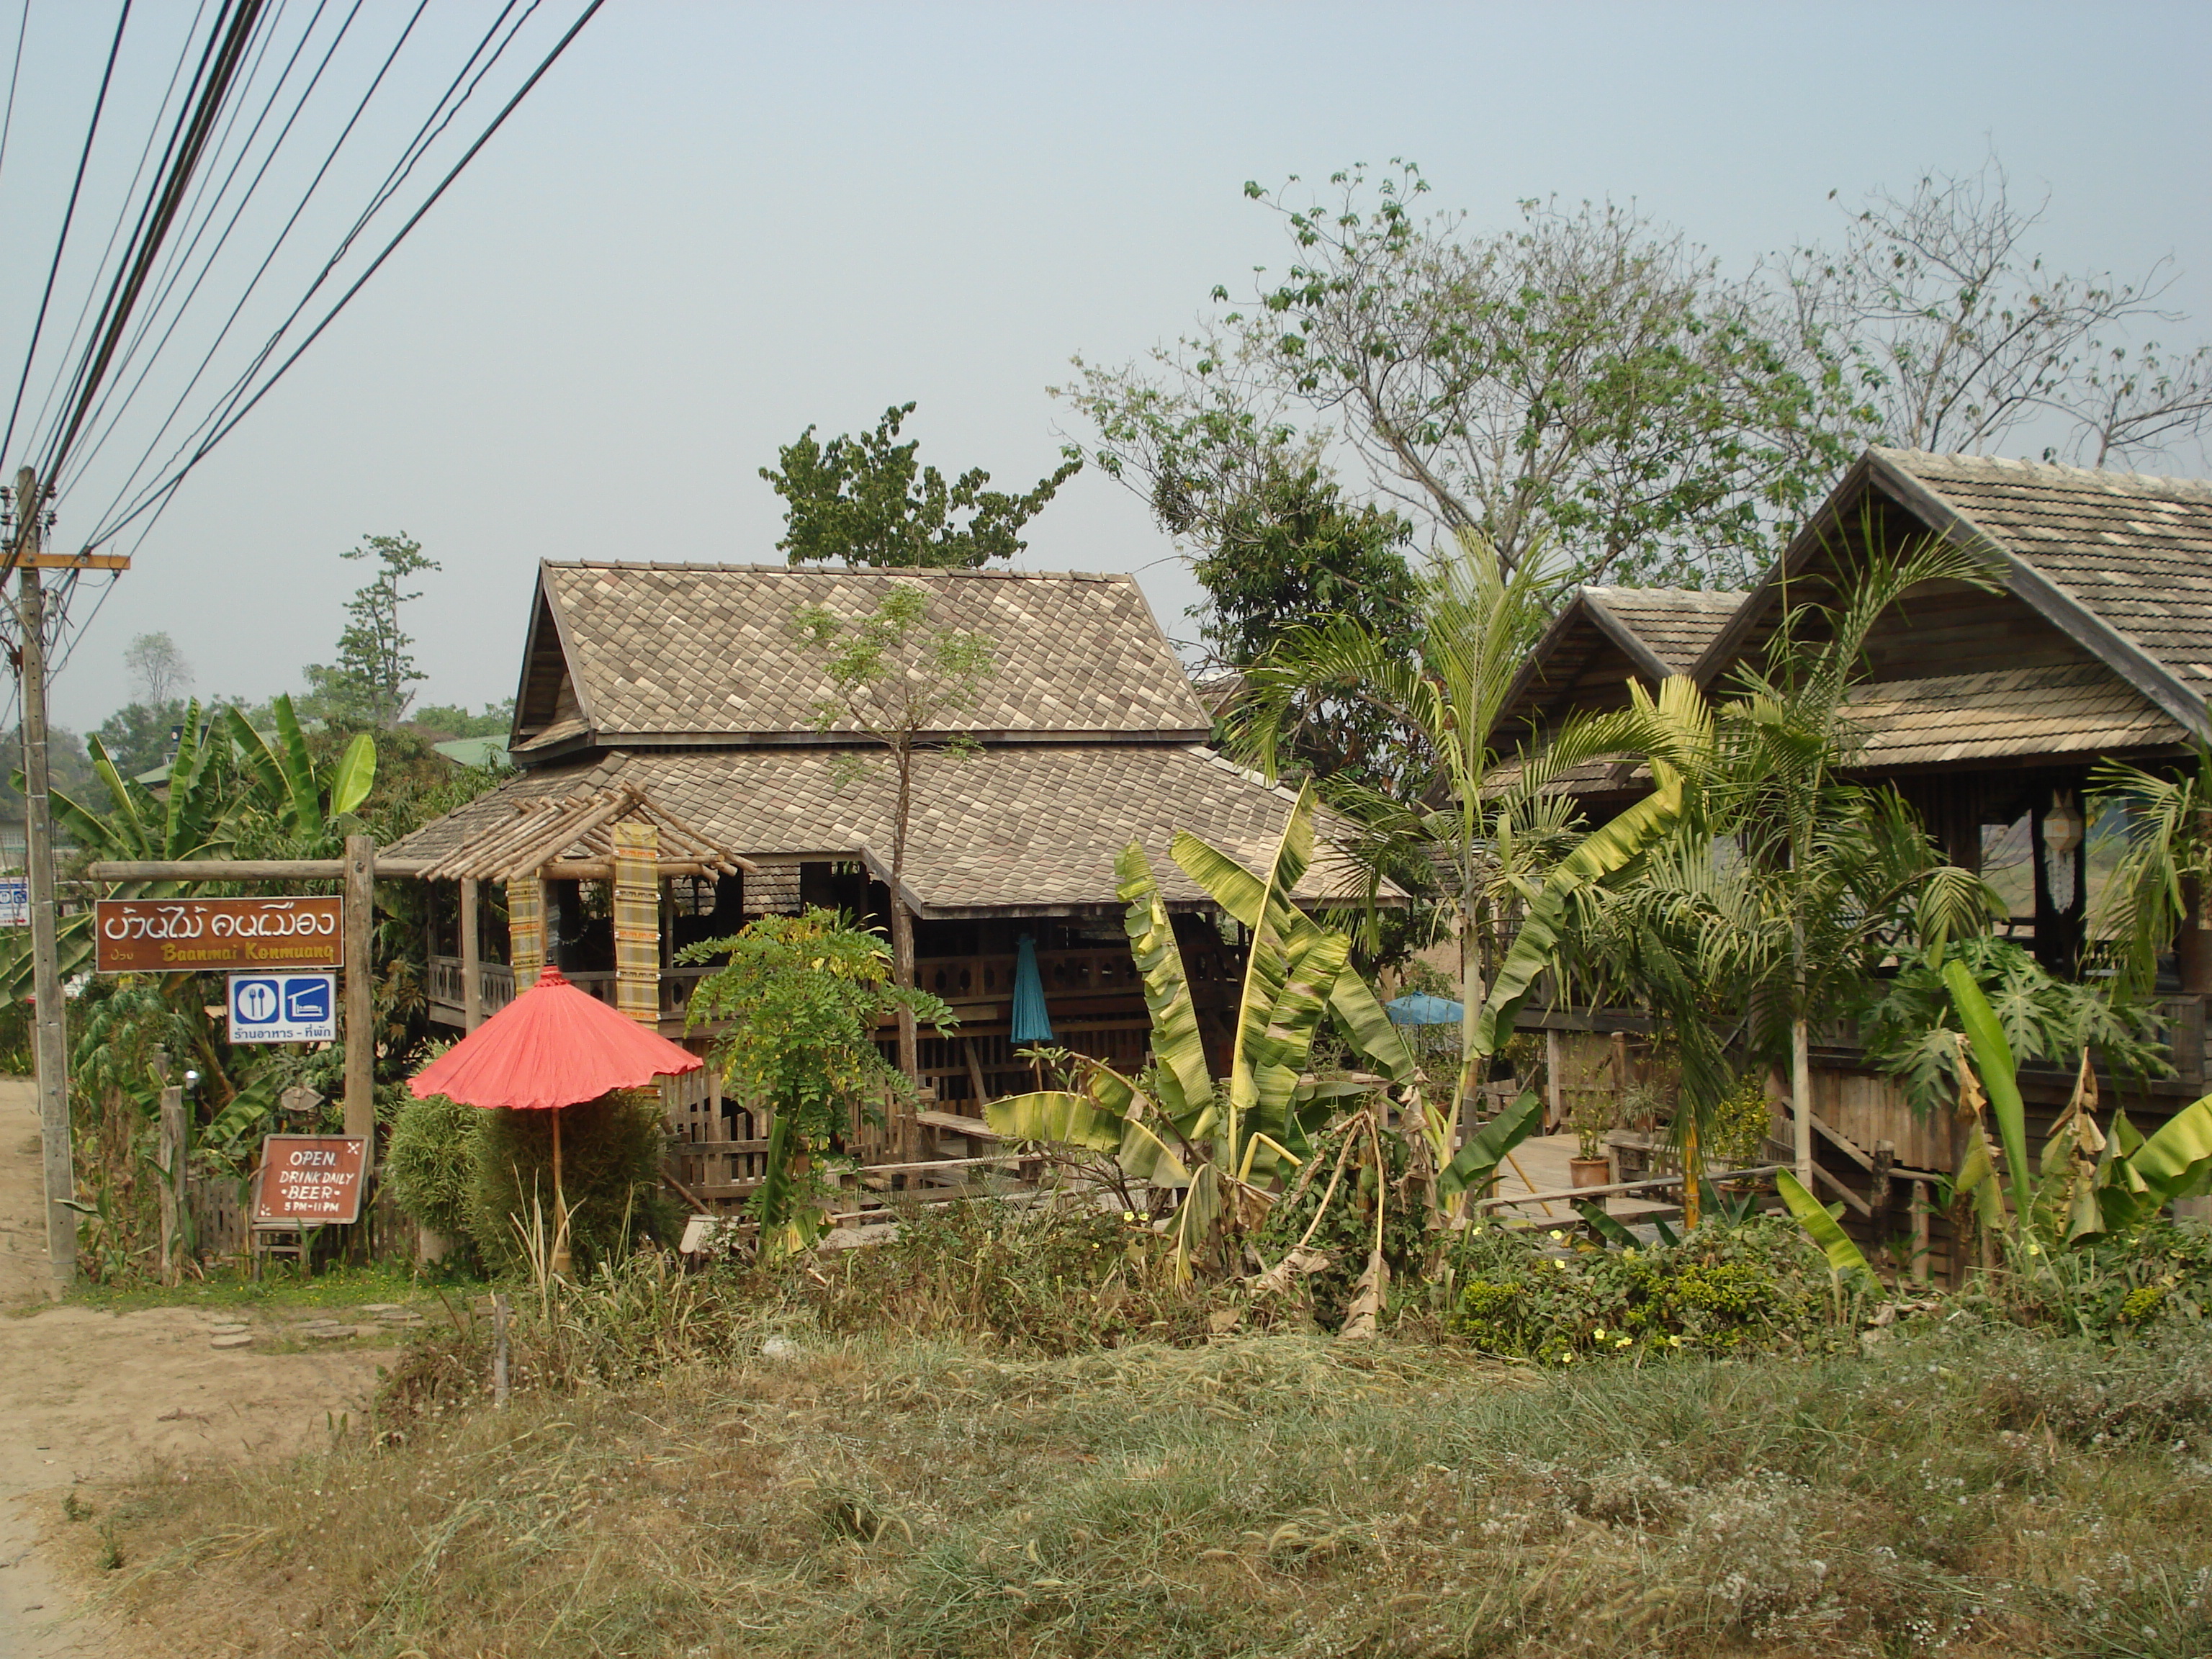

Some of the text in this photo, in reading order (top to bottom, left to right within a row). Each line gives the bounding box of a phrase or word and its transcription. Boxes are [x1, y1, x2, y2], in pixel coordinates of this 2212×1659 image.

[104, 902, 335, 940] บ้านไม้ คนเมือง
[161, 941, 334, 963] Baanmai Konmuang
[234, 1028, 293, 1039] ร้านอาหาร
[305, 1023, 331, 1037] ที่พัก
[279, 1171, 354, 1185] DRINK DAILY
